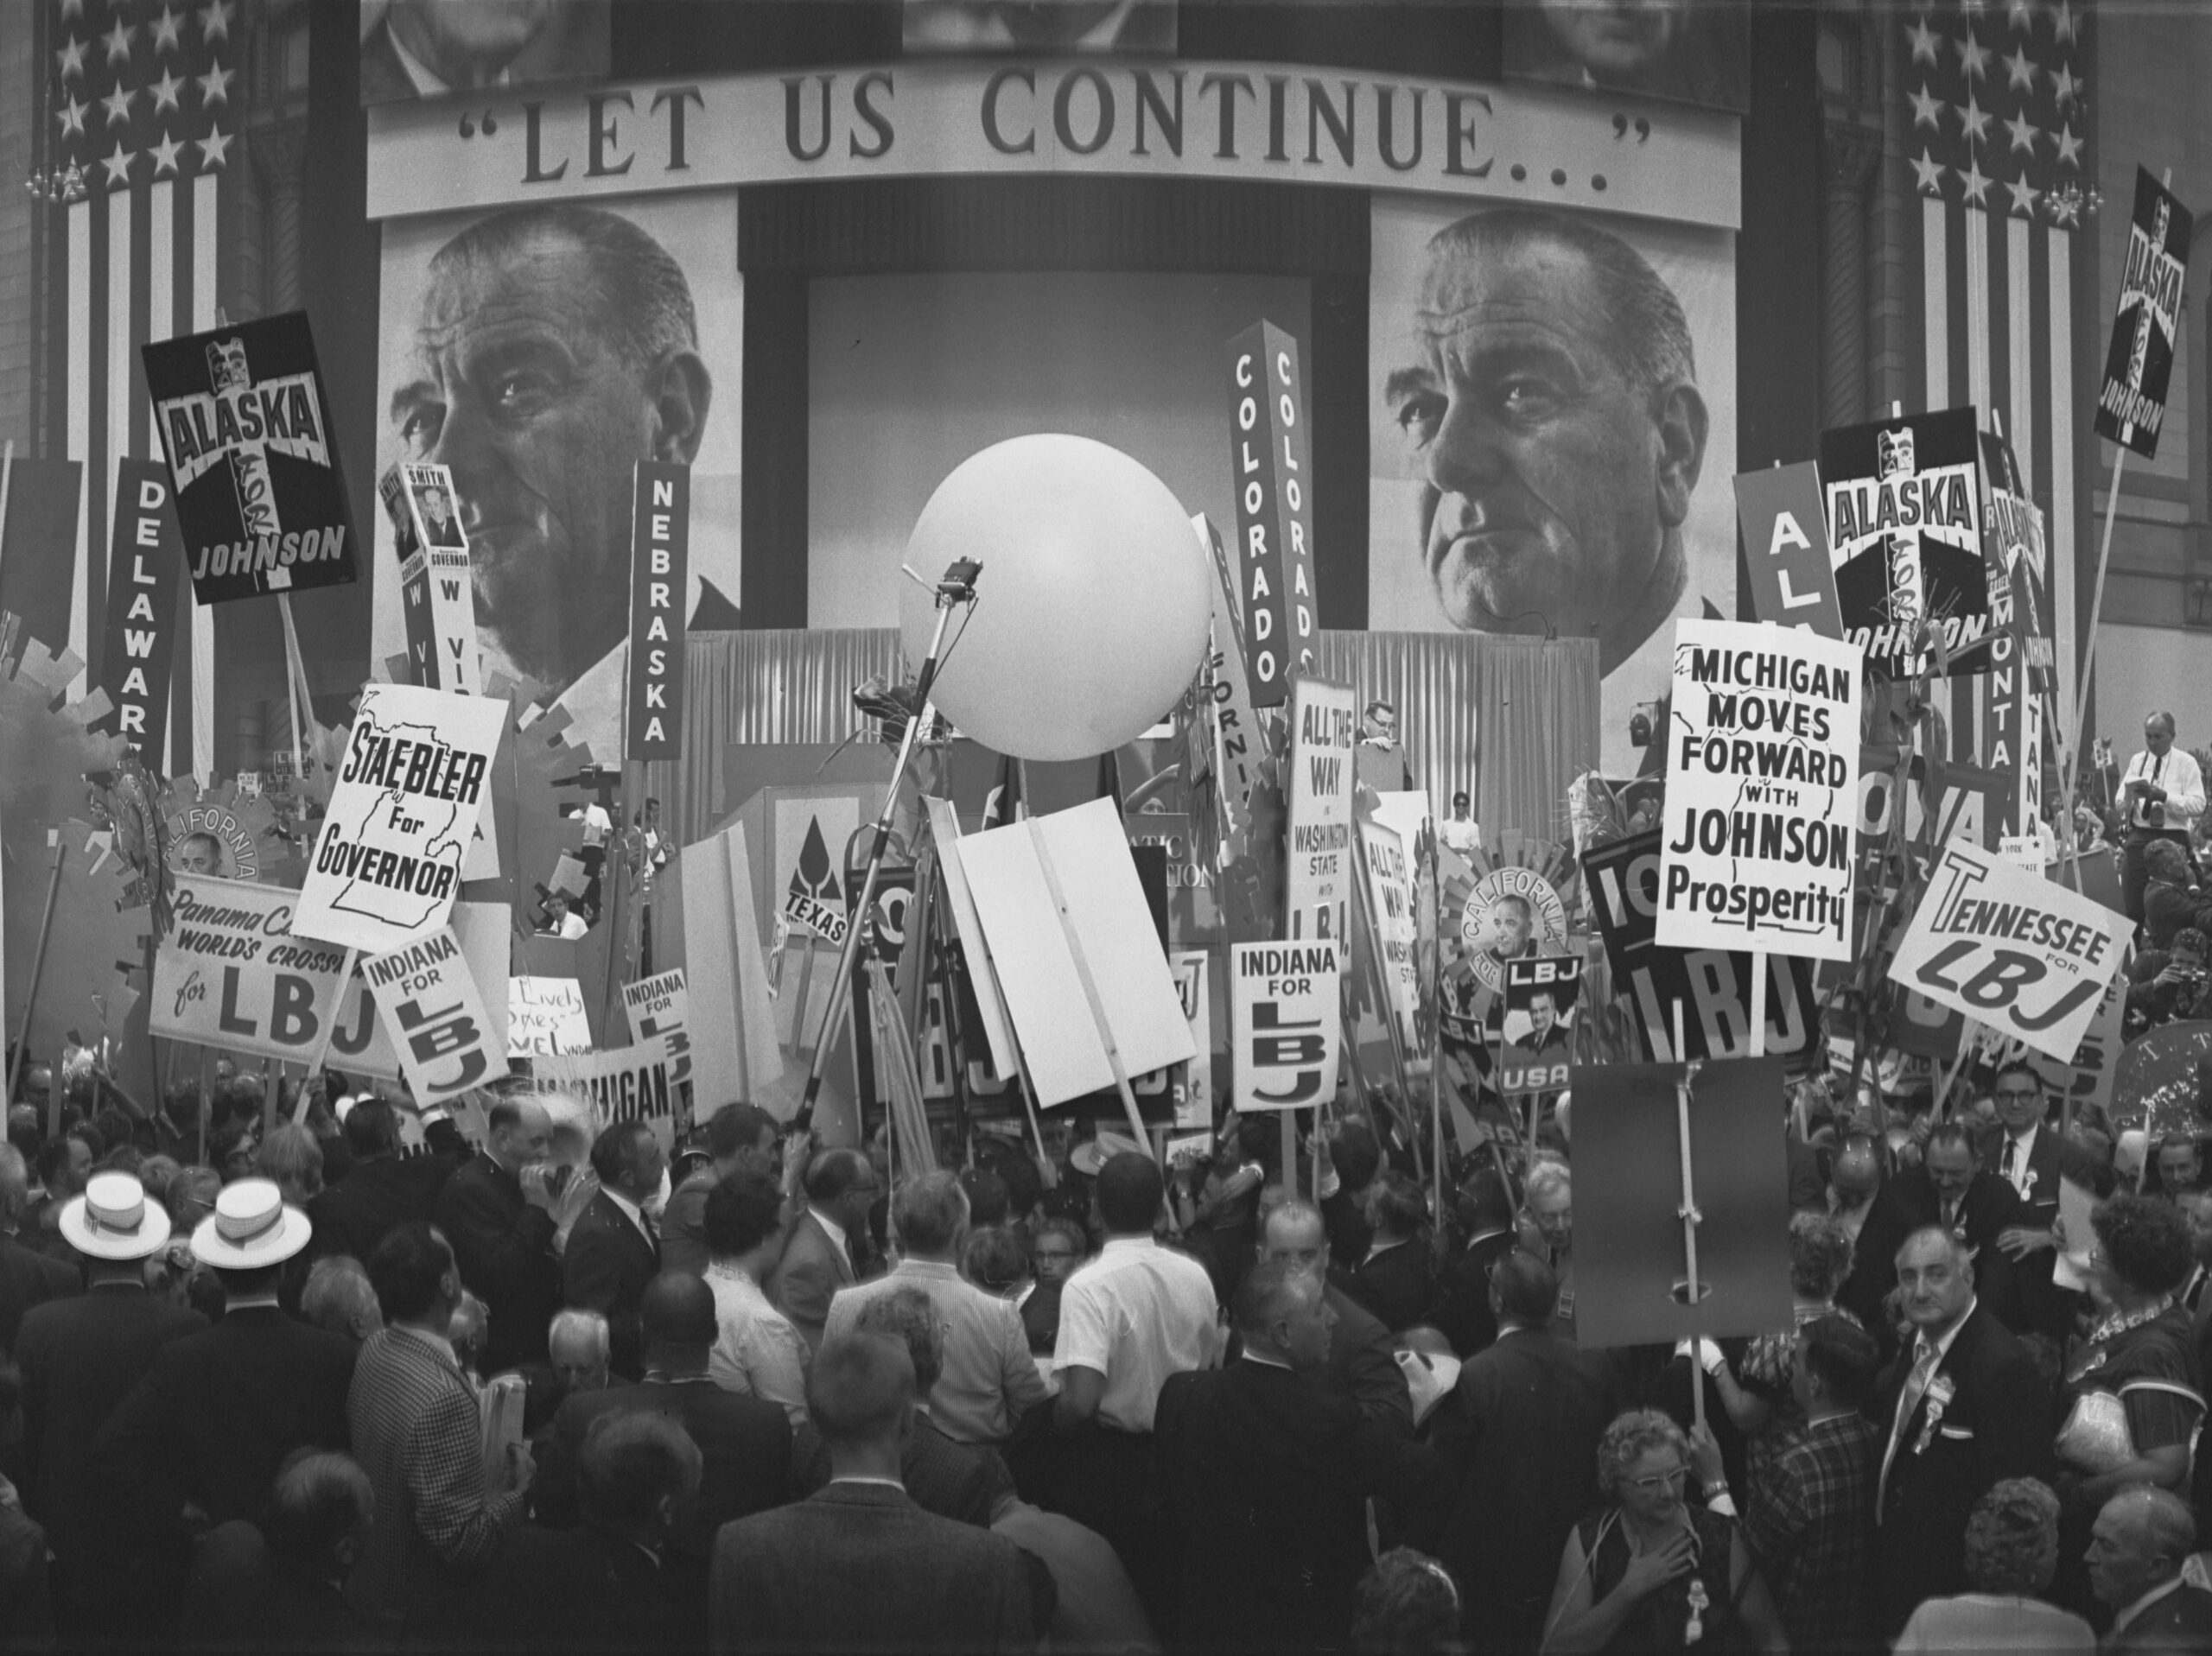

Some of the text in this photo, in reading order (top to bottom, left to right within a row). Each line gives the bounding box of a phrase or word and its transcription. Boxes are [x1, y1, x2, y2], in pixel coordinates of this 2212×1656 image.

[780, 69, 895, 162] US
[2121, 231, 2182, 328] ALASKA
[167, 382, 320, 471] ALASKA
[2100, 375, 2164, 436] JOHNSON
[234, 453, 275, 535] FOR
[408, 469, 446, 485] SMITH
[1236, 354, 1275, 682] COLORADO
[1834, 473, 1974, 550] ALASKA
[192, 524, 346, 580] JOHNSON
[430, 553, 469, 567] GOVERNOR
[1889, 539, 1916, 619] FOR
[119, 479, 165, 752] DELAWAR
[644, 479, 674, 742] NEBRASKA
[1691, 647, 1851, 704] MICHIGAN
[1302, 703, 1352, 749] ALL THE
[1707, 693, 1831, 742] MOVES
[342, 720, 487, 806] STAEBLER
[1311, 755, 1341, 797] WAY
[1681, 735, 1848, 790] FORWARD
[388, 806, 425, 834] For
[1745, 784, 1800, 808] WITH
[1857, 771, 1985, 849] OWA
[162, 808, 257, 879] ALIFORNIA
[316, 822, 454, 900] GOVERNOR
[1295, 822, 1349, 853] WASHINGTON
[1309, 854, 1338, 877] STATE
[1669, 808, 1849, 872] JOHNSON
[173, 889, 264, 931] Panama
[785, 891, 847, 942] TEXAS
[1462, 870, 1567, 944] CALIFORNIA
[1665, 864, 1846, 942] Prosperity
[1929, 850, 2112, 967] TENNESSEE
[176, 928, 262, 961] WORLD'S
[367, 934, 459, 988] INDIANA
[1241, 947, 1337, 977] INDIANA
[1471, 951, 1500, 986] FOR
[2045, 952, 2080, 974] FOR
[401, 968, 443, 996] FOR
[626, 973, 684, 1007] INDIANA
[1268, 978, 1312, 997] FOR
[1510, 960, 1580, 987] LBJ
[1915, 940, 2102, 1031] LBJ
[174, 965, 377, 1056] for LBJ
[645, 997, 672, 1015] FOR
[395, 999, 487, 1094] LBJ
[1252, 1001, 1326, 1104] LBJ
[1503, 1063, 1570, 1090] USA
